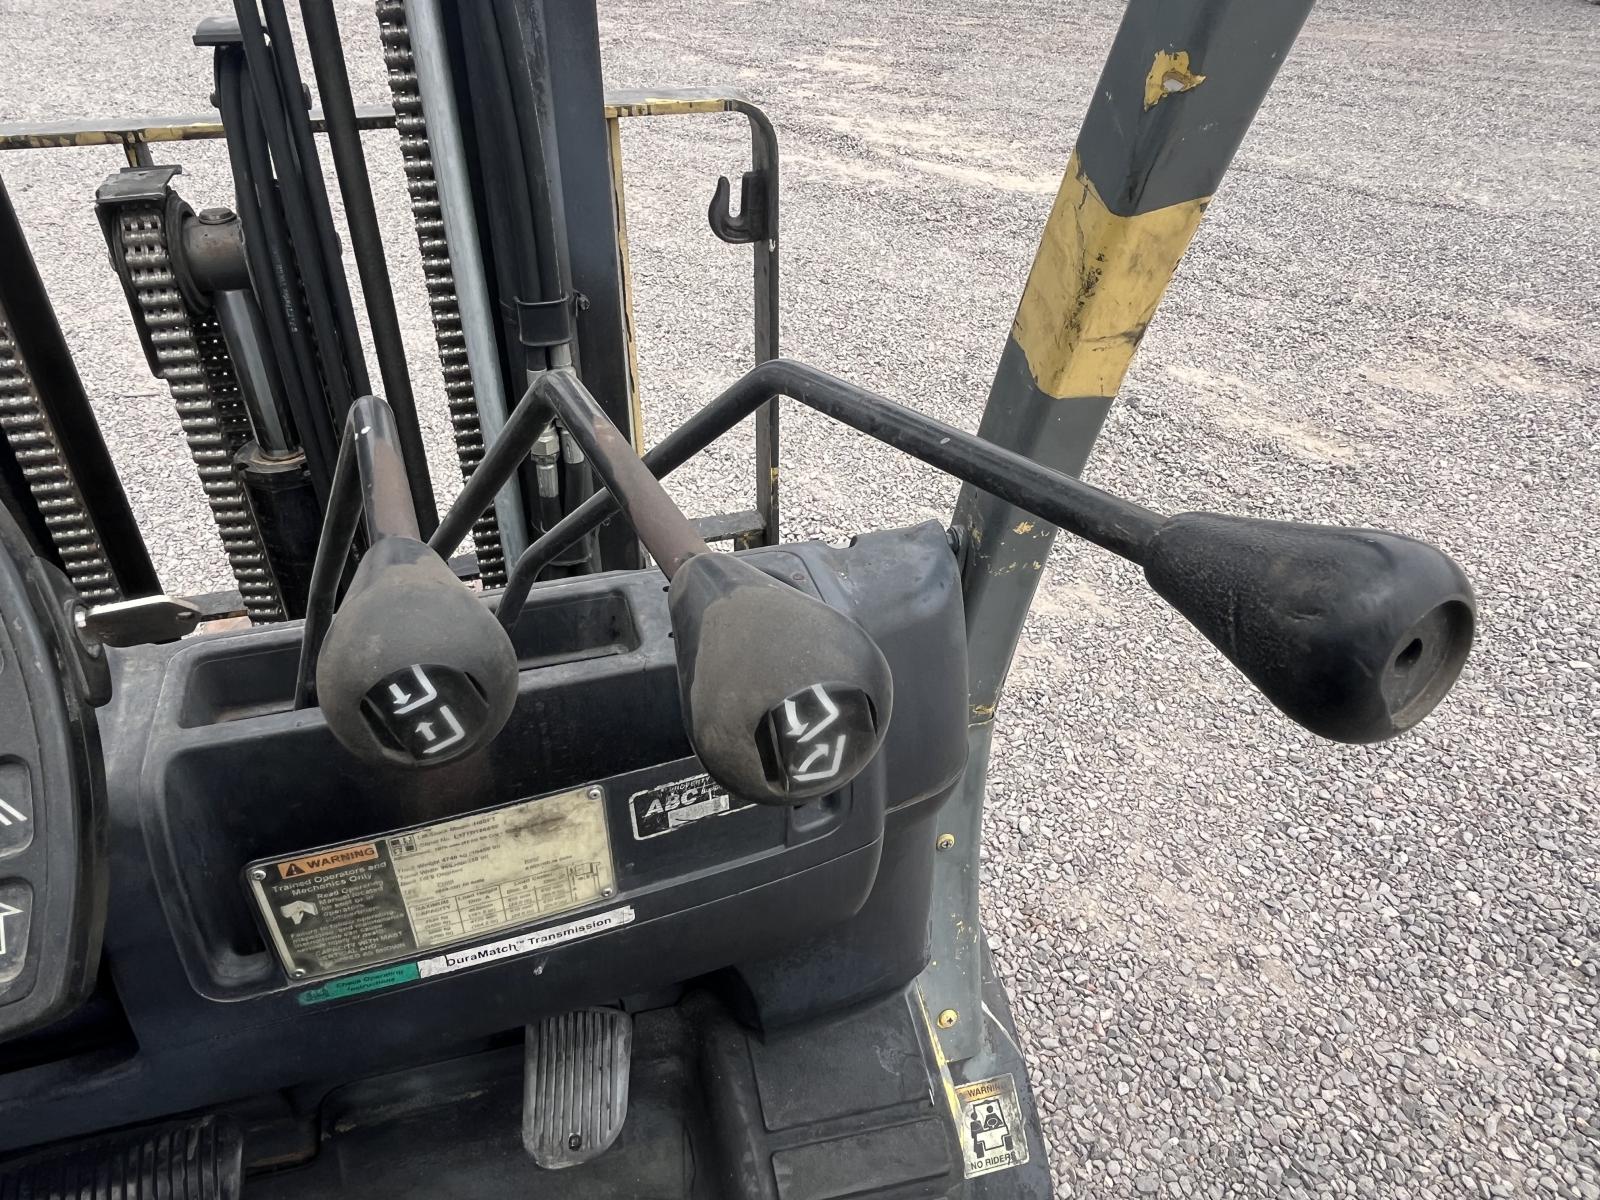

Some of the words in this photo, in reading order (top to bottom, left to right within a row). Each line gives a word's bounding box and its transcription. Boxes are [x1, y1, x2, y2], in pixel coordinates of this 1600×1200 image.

[306, 847, 375, 869] WARNING
[272, 878, 312, 893] Trained
[313, 866, 365, 884] Operators
[367, 861, 387, 871] and
[291, 878, 347, 897] Mechanics
[349, 872, 372, 884] Only
[316, 889, 339, 899] Read
[528, 917, 612, 946] Transmission
[970, 1160, 983, 1170] NO
